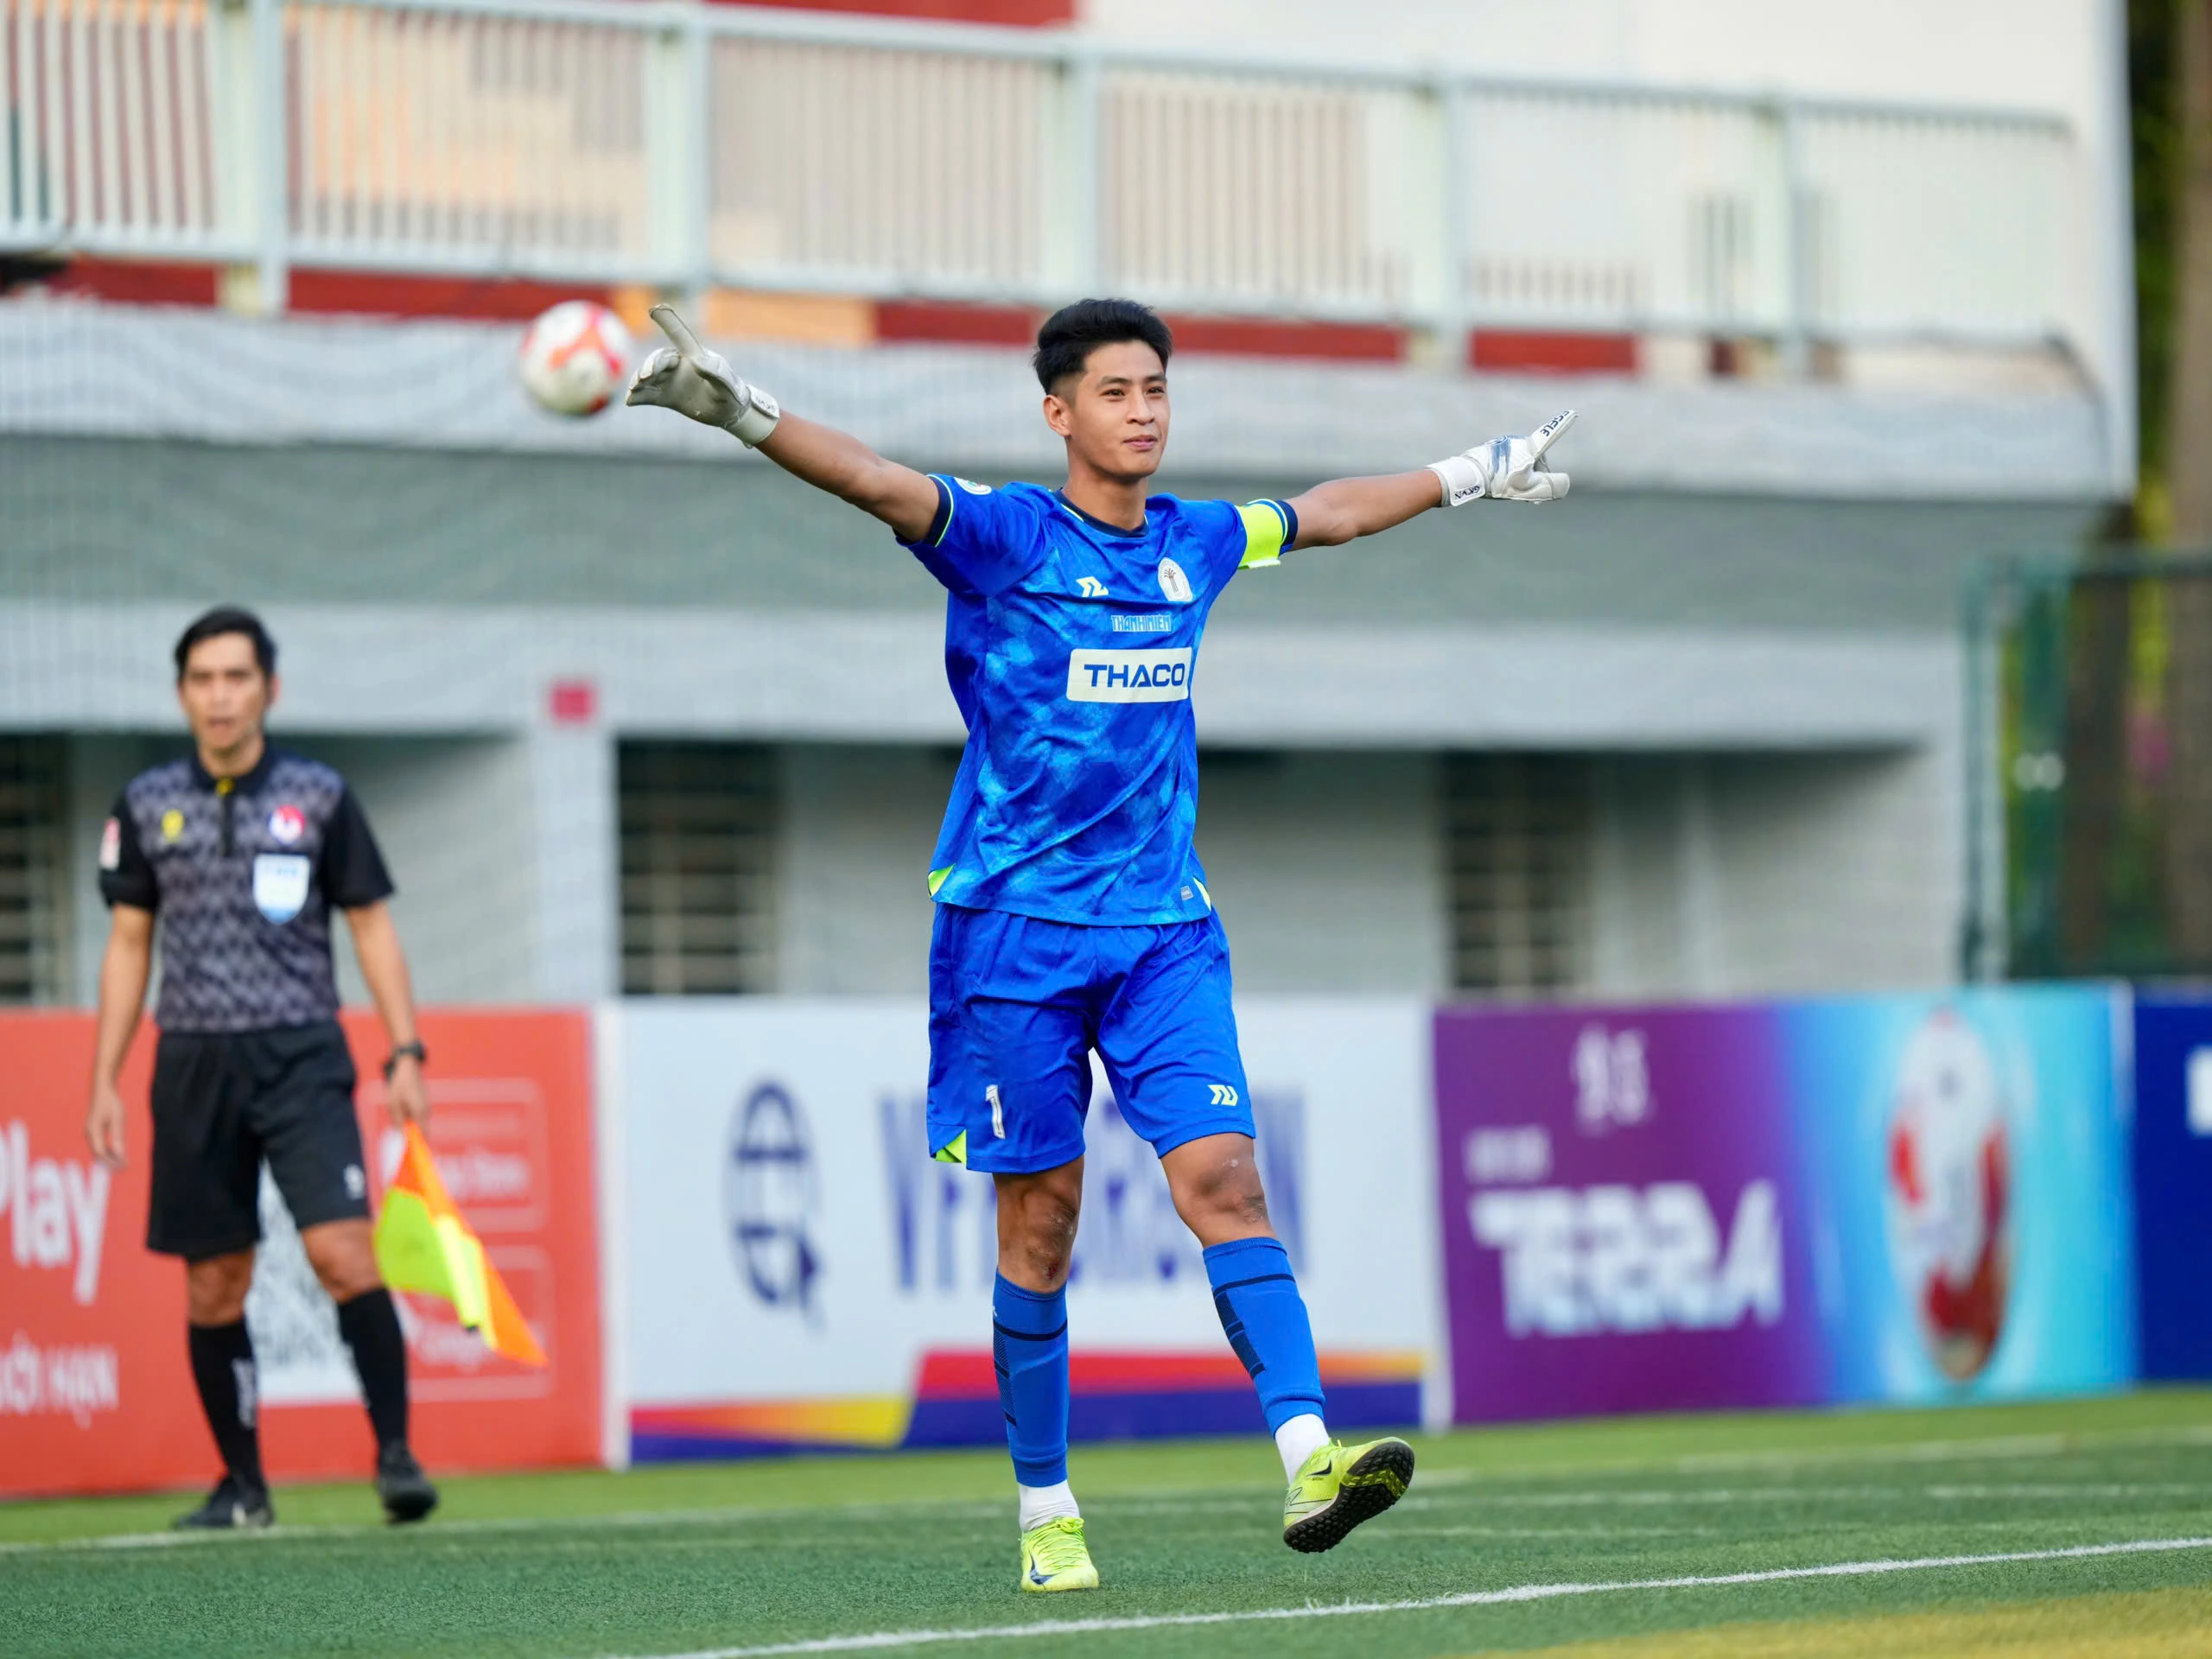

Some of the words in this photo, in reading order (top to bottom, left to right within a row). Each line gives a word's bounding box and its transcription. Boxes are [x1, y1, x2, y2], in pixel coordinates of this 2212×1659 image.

[1110, 615, 1147, 632] THANH
[1084, 663, 1185, 688] THACO
[985, 1084, 1006, 1140] 1
